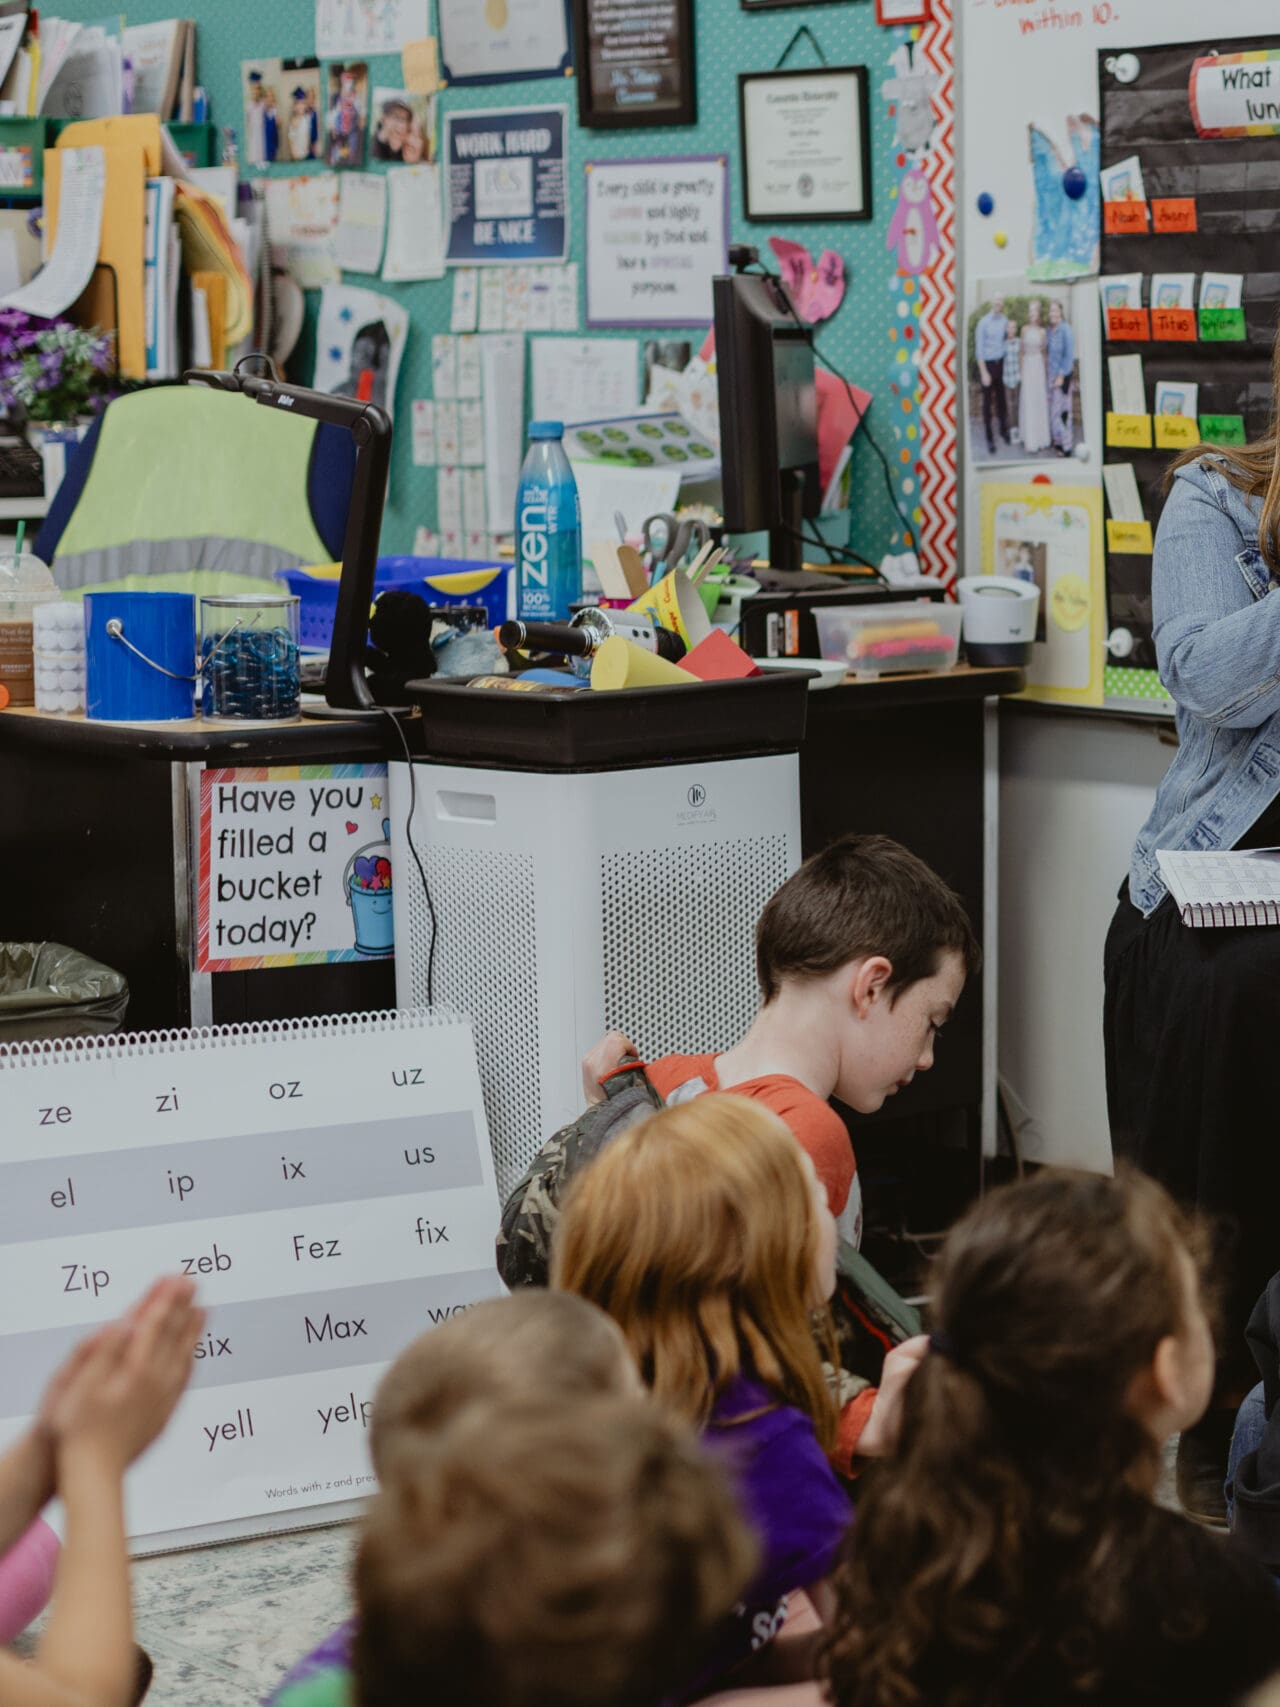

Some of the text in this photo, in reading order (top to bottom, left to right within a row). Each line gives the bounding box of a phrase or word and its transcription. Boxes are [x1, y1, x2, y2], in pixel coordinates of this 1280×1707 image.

[1221, 66, 1271, 91] What
[1158, 316, 1190, 331] Titus
[520, 505, 549, 588] zen
[218, 786, 363, 817] Have you
[218, 827, 327, 858] filled a
[217, 868, 322, 902] bucket
[215, 911, 316, 948] today?
[38, 1068, 425, 1126] ze zi oz uz
[50, 1146, 436, 1208] el ip ix us
[61, 1217, 450, 1297] Zip zeb Fez fix
[193, 1333, 232, 1359] six
[305, 1313, 368, 1343] Max
[203, 1408, 254, 1452] yell
[265, 1485, 298, 1499] Words
[301, 1481, 322, 1493] with
[334, 1475, 352, 1488] and
